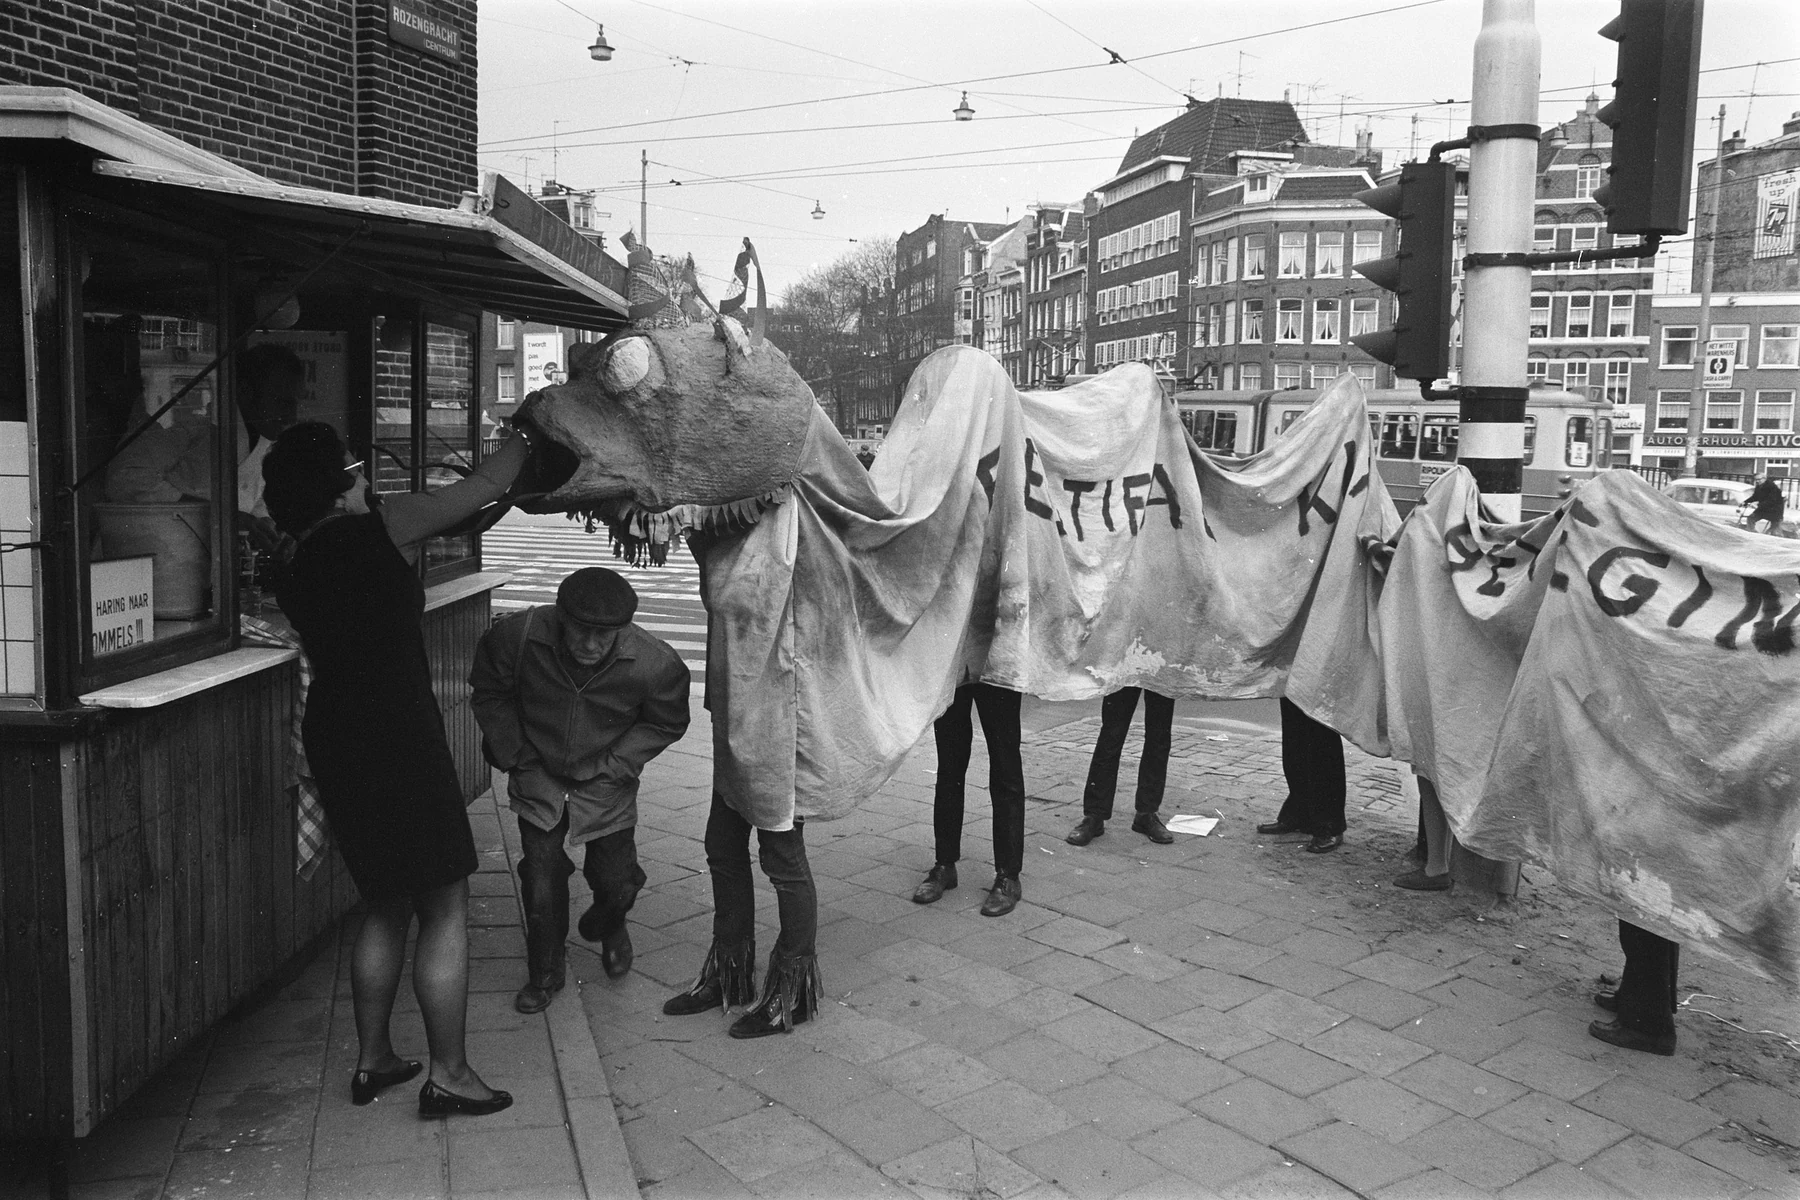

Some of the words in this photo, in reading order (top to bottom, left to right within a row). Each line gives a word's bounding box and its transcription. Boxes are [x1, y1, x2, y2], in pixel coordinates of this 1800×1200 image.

[393, 6, 458, 46] ROZENGRACHT
[1706, 349, 1735, 357] WARENHUIS
[528, 364, 543, 372] goed
[96, 597, 125, 616] HARING
[129, 593, 149, 610] NAAR
